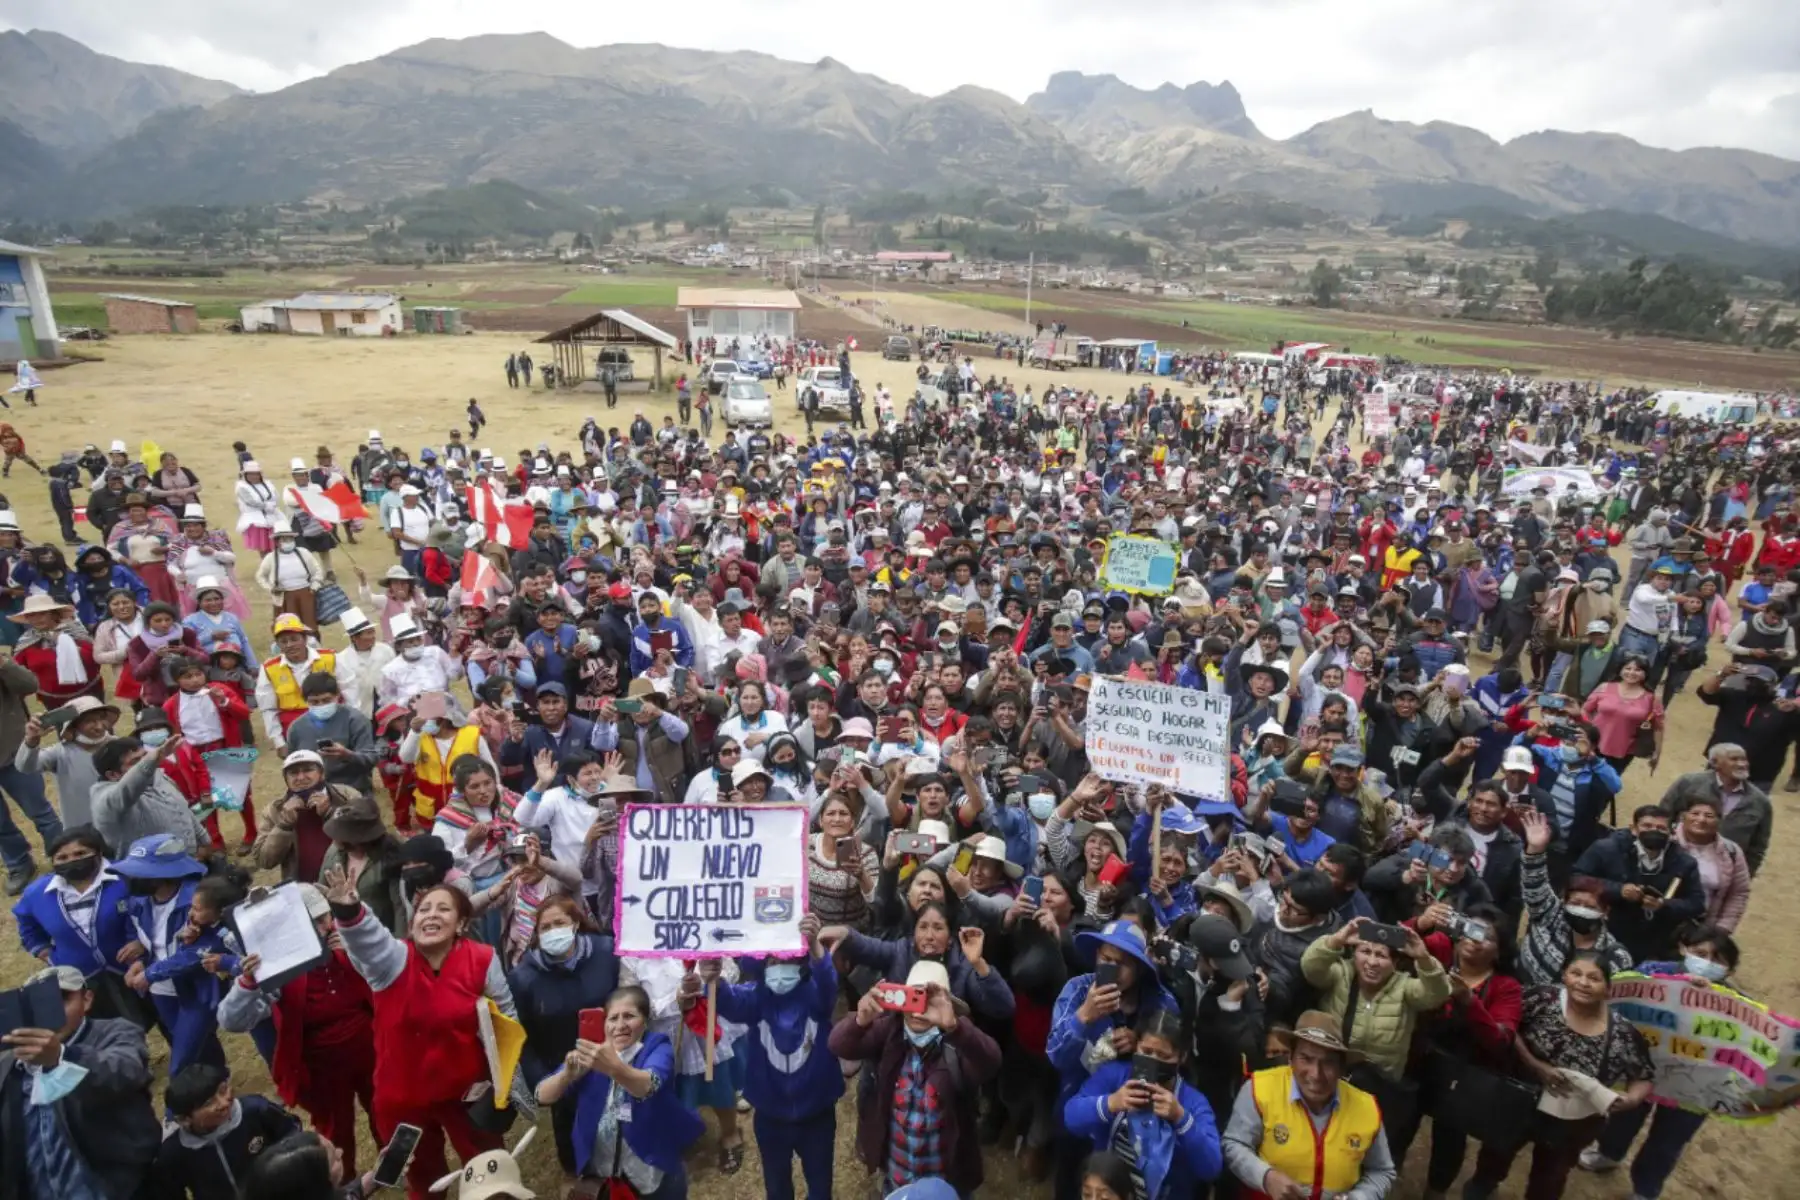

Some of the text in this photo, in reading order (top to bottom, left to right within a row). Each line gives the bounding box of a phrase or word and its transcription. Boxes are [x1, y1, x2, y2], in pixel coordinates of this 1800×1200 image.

[1117, 687, 1173, 704] ESCUELA
[1180, 695, 1198, 707] ES
[1204, 699, 1222, 714] MI
[1093, 720, 1108, 732] SE
[1115, 723, 1140, 740] ESTA
[1095, 703, 1151, 723] SEGUNDO
[1162, 711, 1206, 730] HOGAR
[628, 807, 754, 841] QUEREMOS
[639, 843, 762, 881] UN NUEVO
[645, 881, 744, 921] COLEGIO
